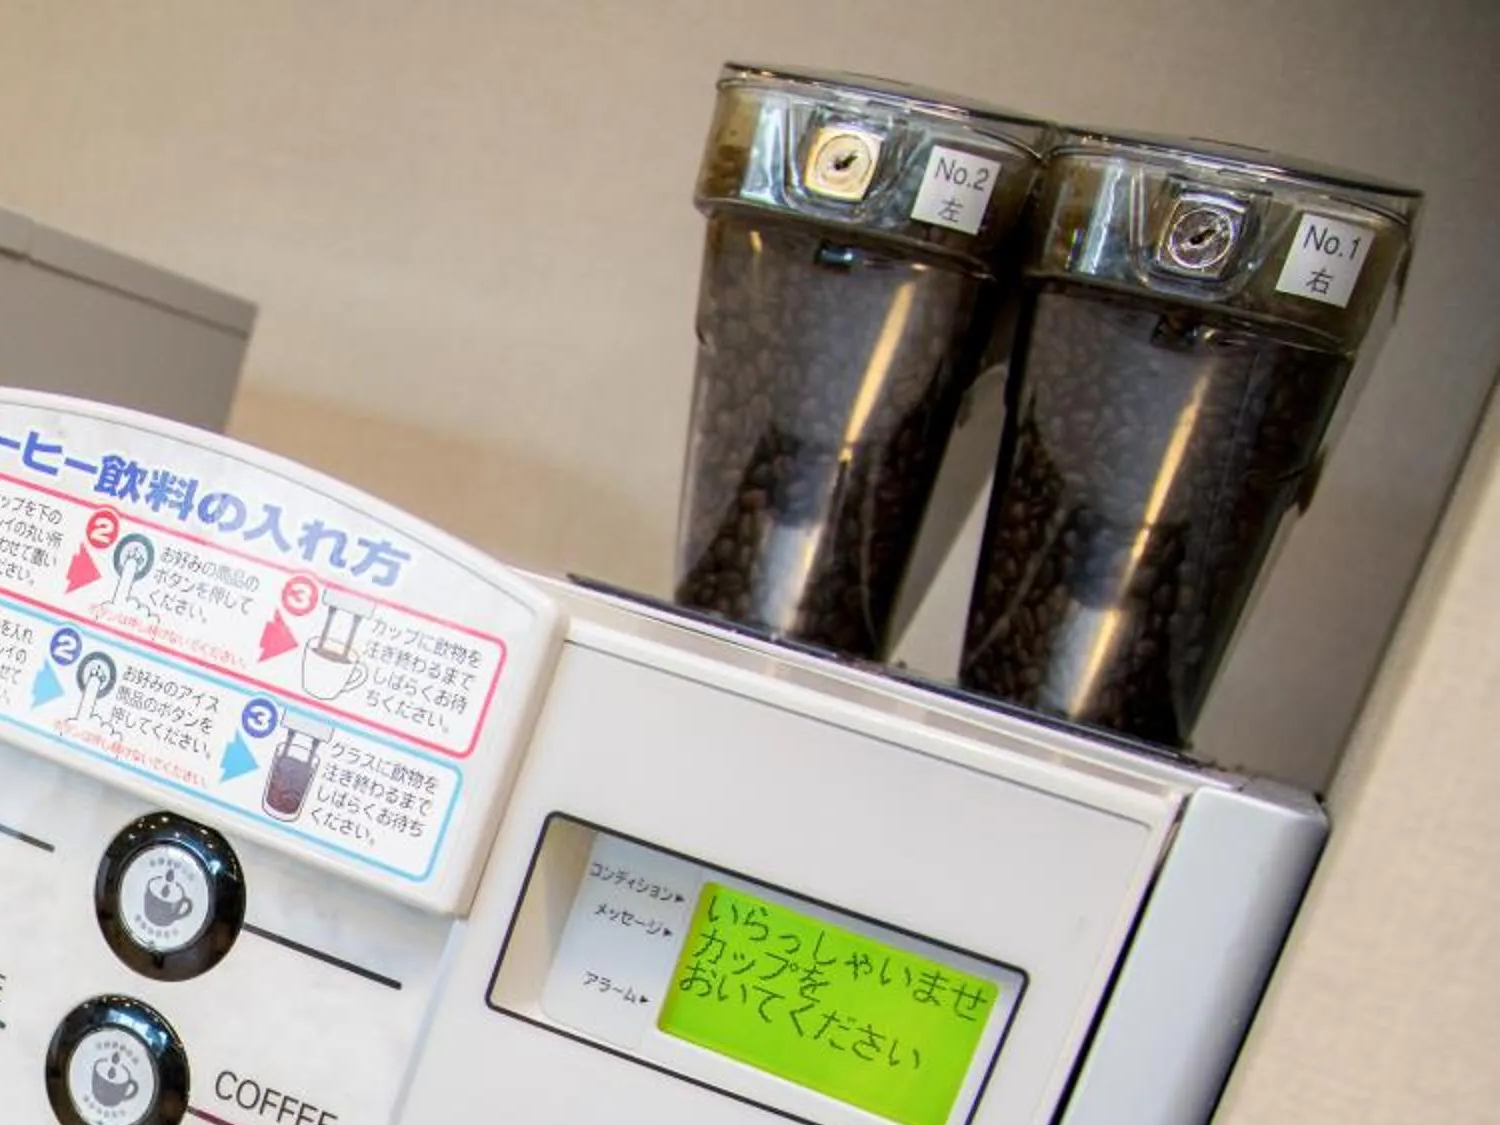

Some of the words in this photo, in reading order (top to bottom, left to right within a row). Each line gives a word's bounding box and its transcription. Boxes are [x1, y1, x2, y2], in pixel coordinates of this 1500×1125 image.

[934, 156, 990, 192] No.2
[939, 198, 963, 224] 左
[1303, 224, 1361, 259] No.1
[1306, 268, 1332, 295] 右
[153, 566, 256, 615] ボタンを押して
[160, 545, 260, 592] お好みの商品の
[149, 589, 207, 624] ください。
[371, 617, 484, 669] カップに飲物を
[115, 684, 213, 736] 商品のボタンを
[122, 664, 220, 714] お好みのアイス
[366, 690, 450, 734] ちください。
[372, 665, 469, 717] しばらくお待
[111, 705, 212, 760] 押してください。
[330, 741, 439, 795] グラスに飲物を
[311, 806, 376, 846] ください。
[316, 785, 428, 838] しばらくお待ち
[590, 862, 675, 903] コンディション
[593, 903, 662, 938] メッセージ
[692, 929, 832, 994] カップを
[706, 894, 989, 1022] いらっしゃいませ
[582, 970, 640, 1006] アラーム
[678, 962, 923, 1071] おいてください
